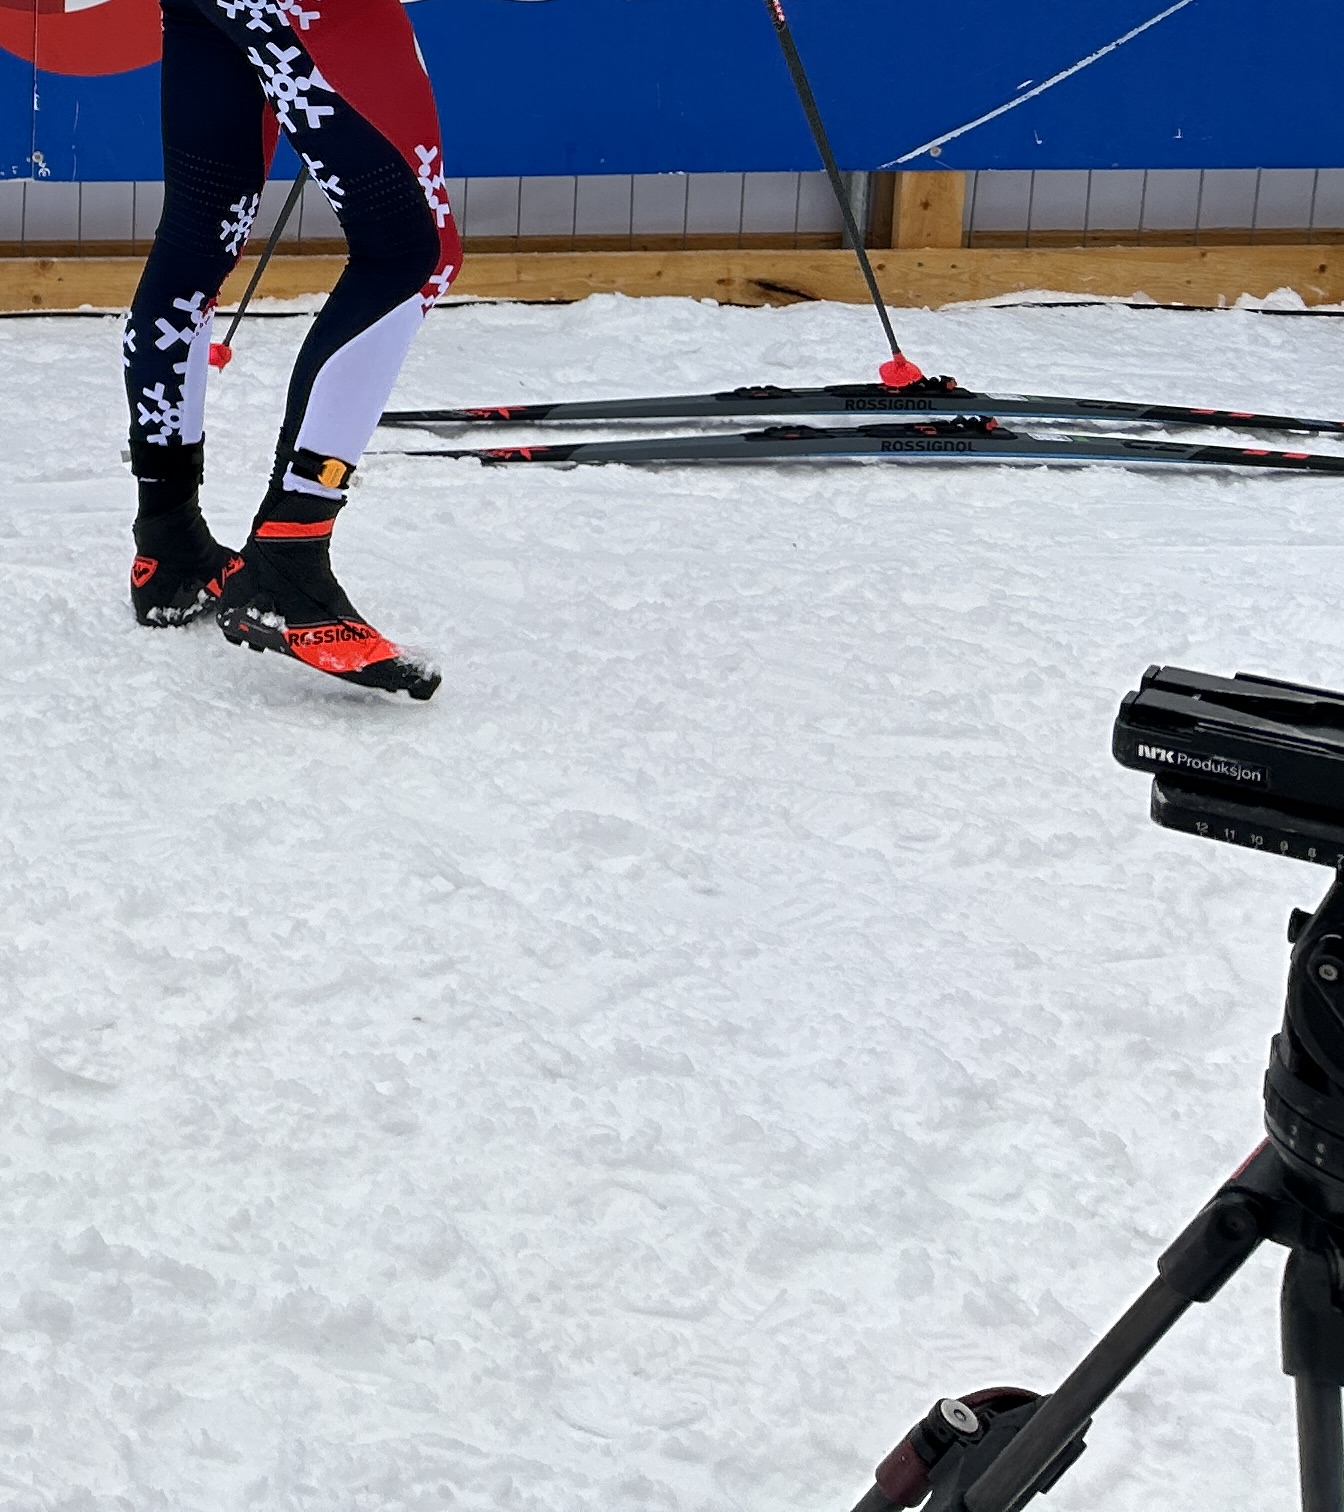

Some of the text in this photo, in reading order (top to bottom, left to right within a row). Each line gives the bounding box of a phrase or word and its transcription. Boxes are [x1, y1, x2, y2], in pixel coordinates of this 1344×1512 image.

[844, 398, 938, 412] ROSSIGNOL
[879, 440, 978, 454] ROSSIGNOL
[1137, 743, 1262, 782] nrk Produksjon
[1195, 821, 1209, 834] 12
